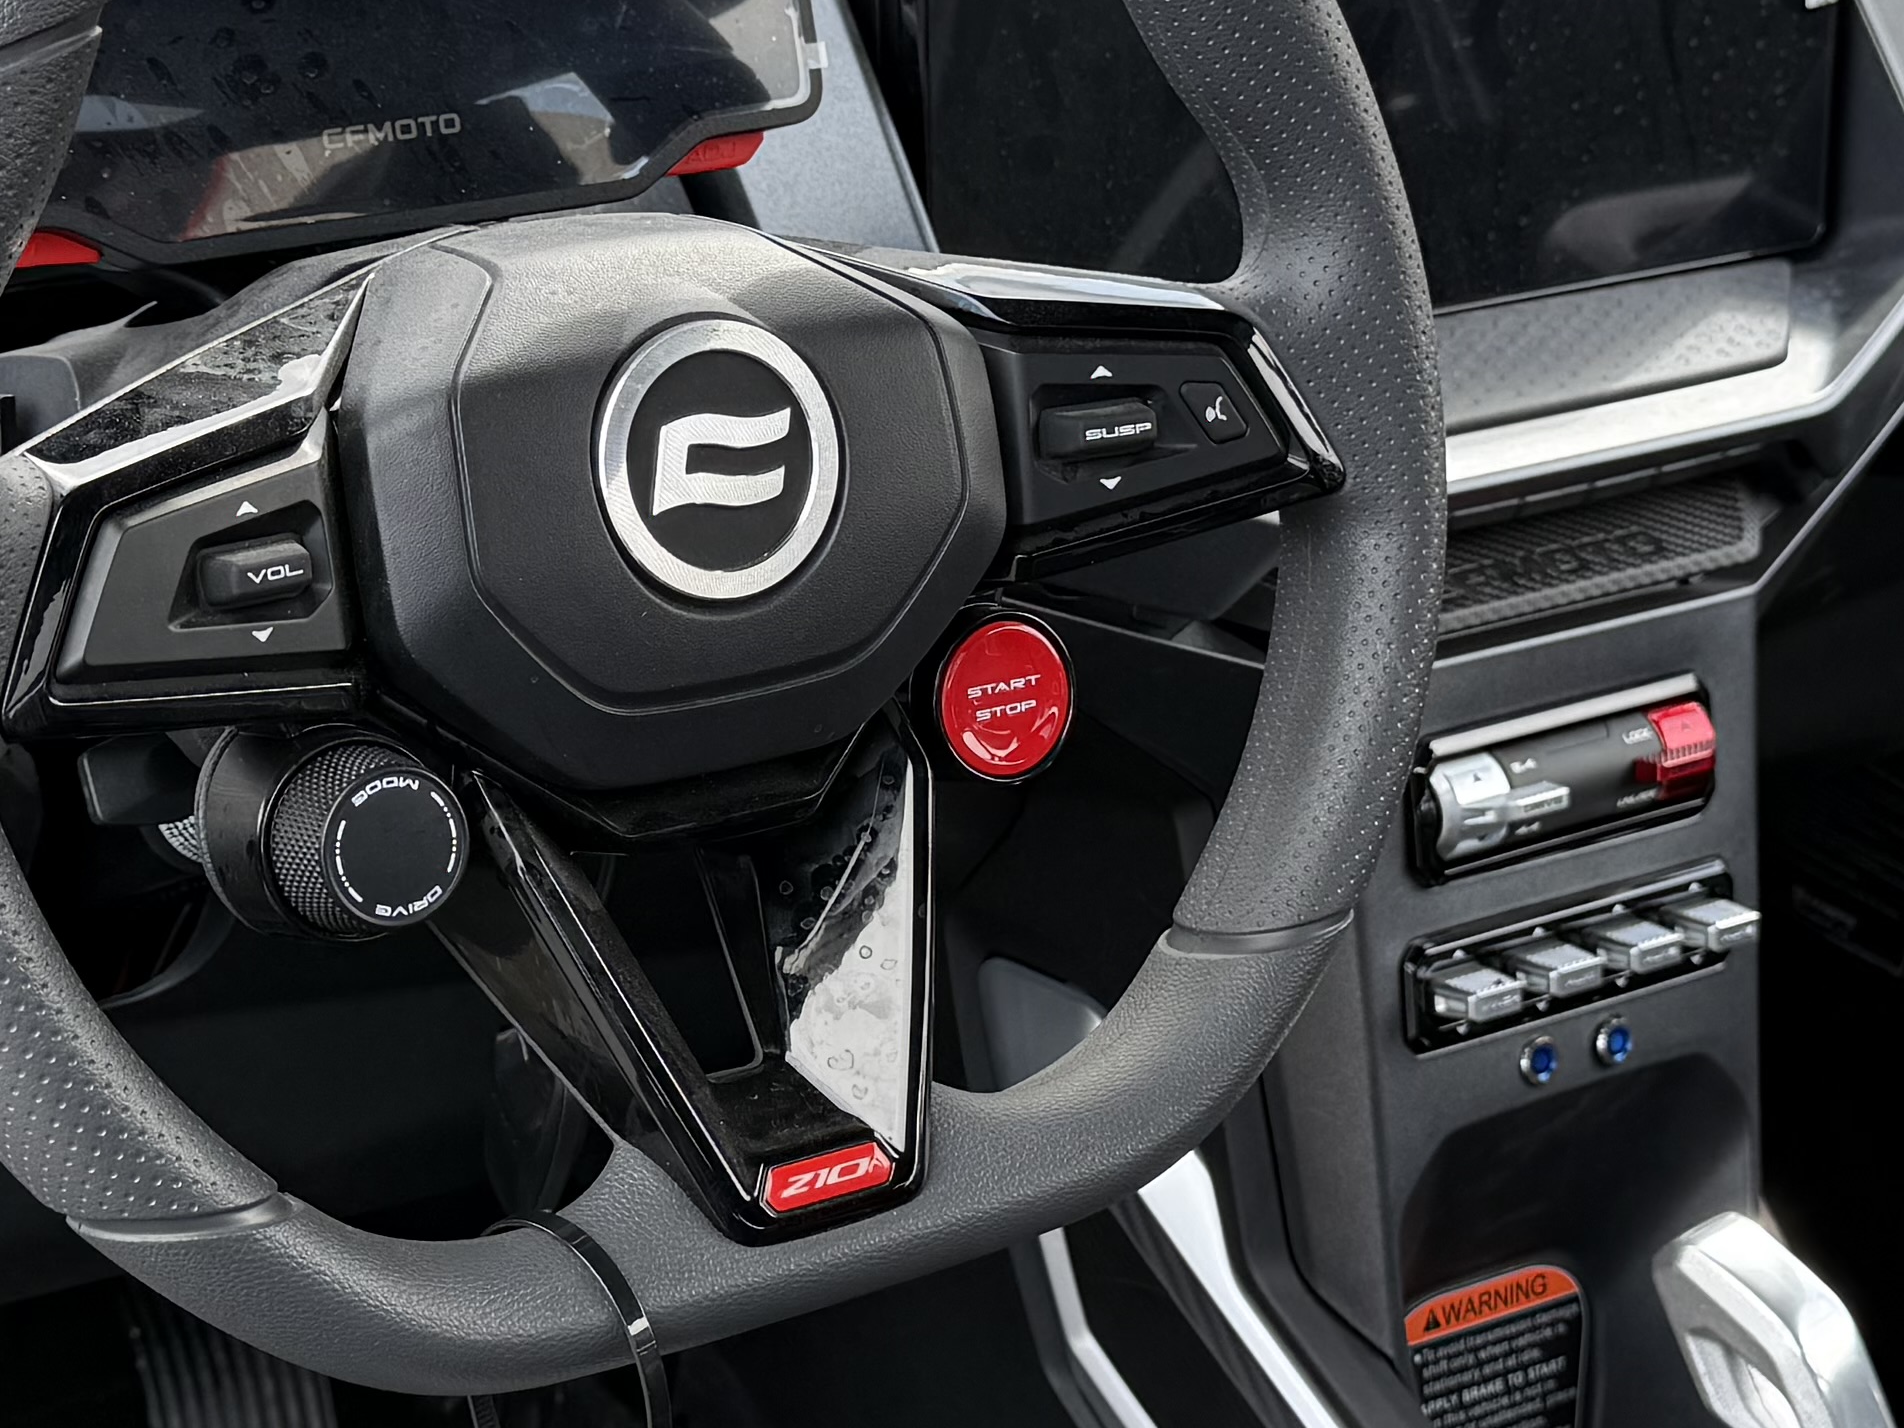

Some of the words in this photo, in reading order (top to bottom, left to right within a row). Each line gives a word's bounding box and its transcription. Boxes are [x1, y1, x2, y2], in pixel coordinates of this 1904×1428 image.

[322, 111, 462, 153] CFMOTO
[1084, 421, 1154, 442] SUSP
[246, 566, 304, 586] VOL
[966, 670, 1042, 700] START
[975, 698, 1038, 725] STOP
[351, 776, 420, 808] MODE
[374, 884, 444, 918] DRIVE
[1440, 1273, 1548, 1327] WARNING
